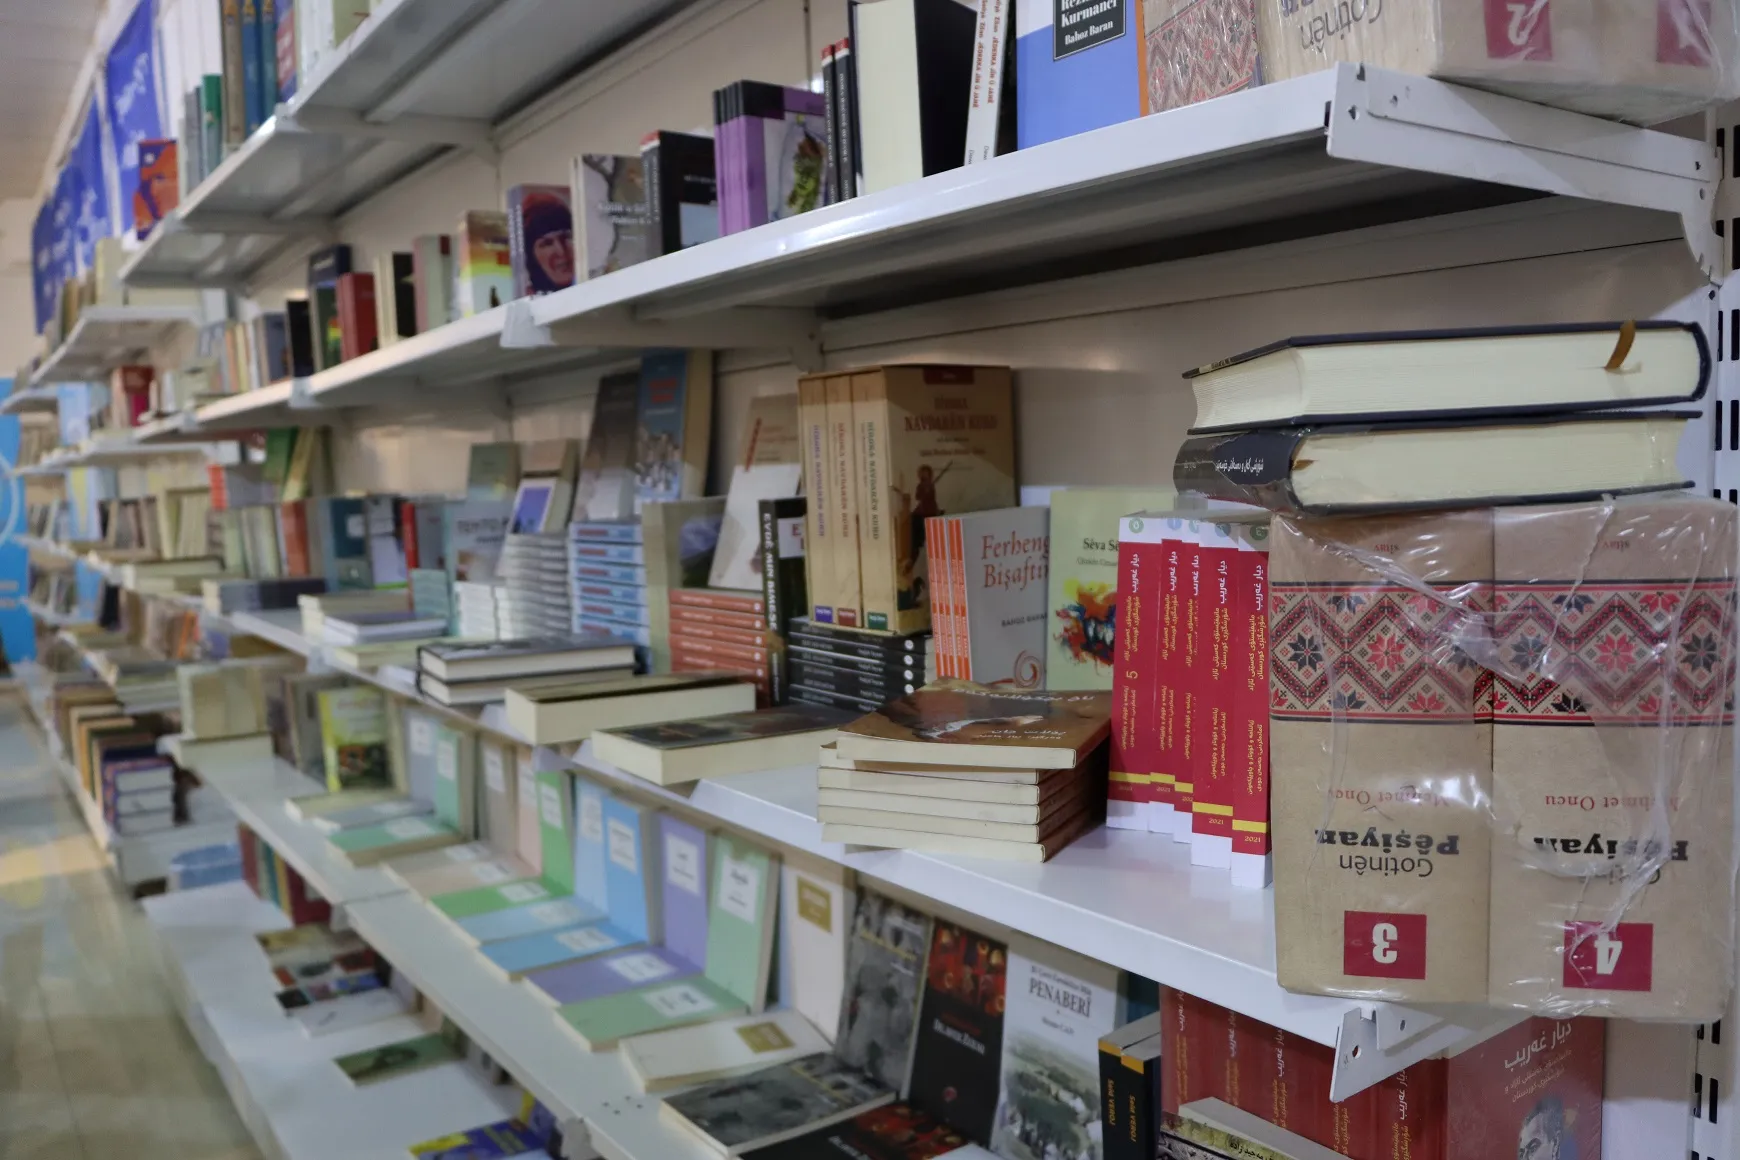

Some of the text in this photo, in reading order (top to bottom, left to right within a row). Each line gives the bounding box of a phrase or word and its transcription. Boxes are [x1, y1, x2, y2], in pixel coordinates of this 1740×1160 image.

[1065, 20, 1113, 45] Bahoz Baran
[1253, 565, 1263, 611] دیار غەریب
[1126, 670, 1138, 679] 5
[1244, 835, 1261, 843] 2021
[1339, 854, 1433, 878] Gotinên
[1372, 922, 1398, 964] 3
[1594, 931, 1623, 975] 4
[1504, 1021, 1572, 1072] دیار غەریب
